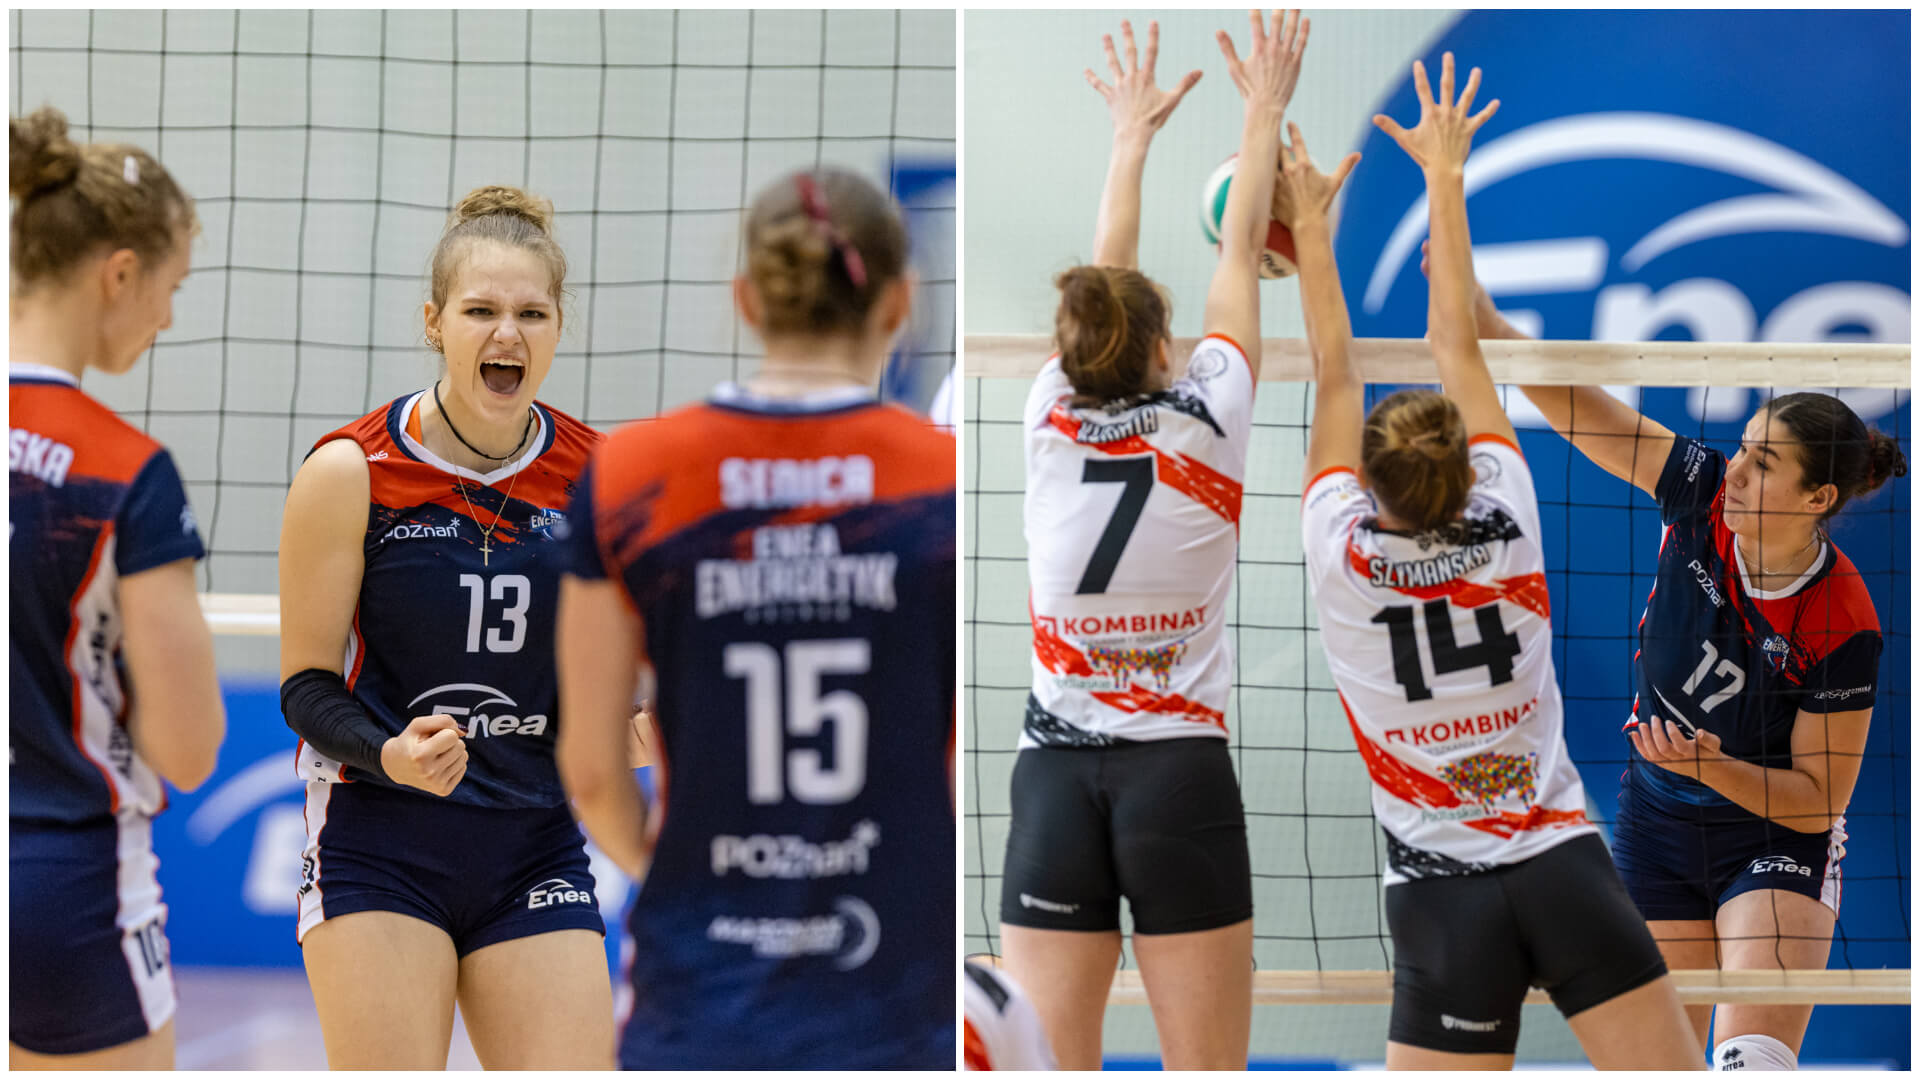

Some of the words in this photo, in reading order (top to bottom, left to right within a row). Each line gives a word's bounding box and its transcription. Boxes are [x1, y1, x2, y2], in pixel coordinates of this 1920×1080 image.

[1075, 456, 1155, 595] 7
[1368, 543, 1491, 588] SZYMAŃSKA
[459, 574, 531, 653] 13
[1063, 605, 1208, 636] KOMBINAT
[1370, 597, 1522, 702] 14
[1682, 639, 1745, 714] 17
[722, 638, 871, 805] 15
[527, 888, 592, 910] Enea
[1752, 860, 1812, 878] Enea
